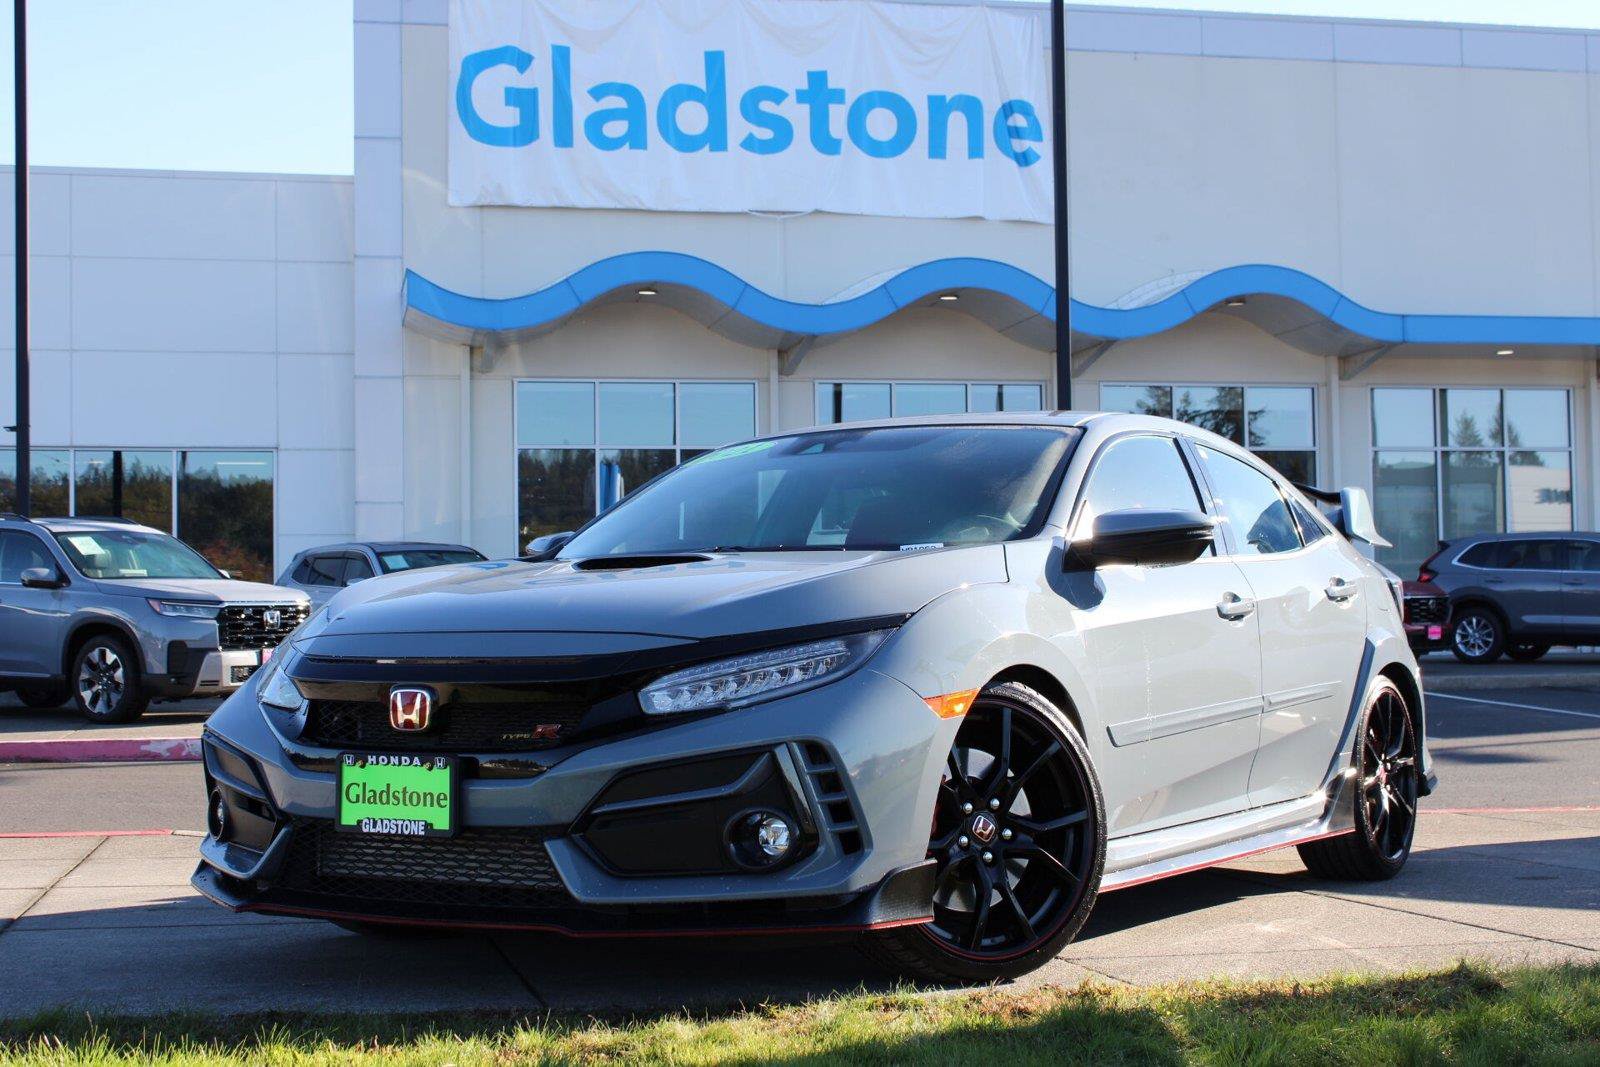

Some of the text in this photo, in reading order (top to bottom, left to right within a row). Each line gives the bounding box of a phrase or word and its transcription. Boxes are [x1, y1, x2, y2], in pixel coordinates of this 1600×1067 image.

[456, 44, 1043, 168] Gladstone
[367, 755, 421, 767] HONDA
[344, 782, 448, 809] Gladstone
[361, 818, 425, 836] GLADSTONE
